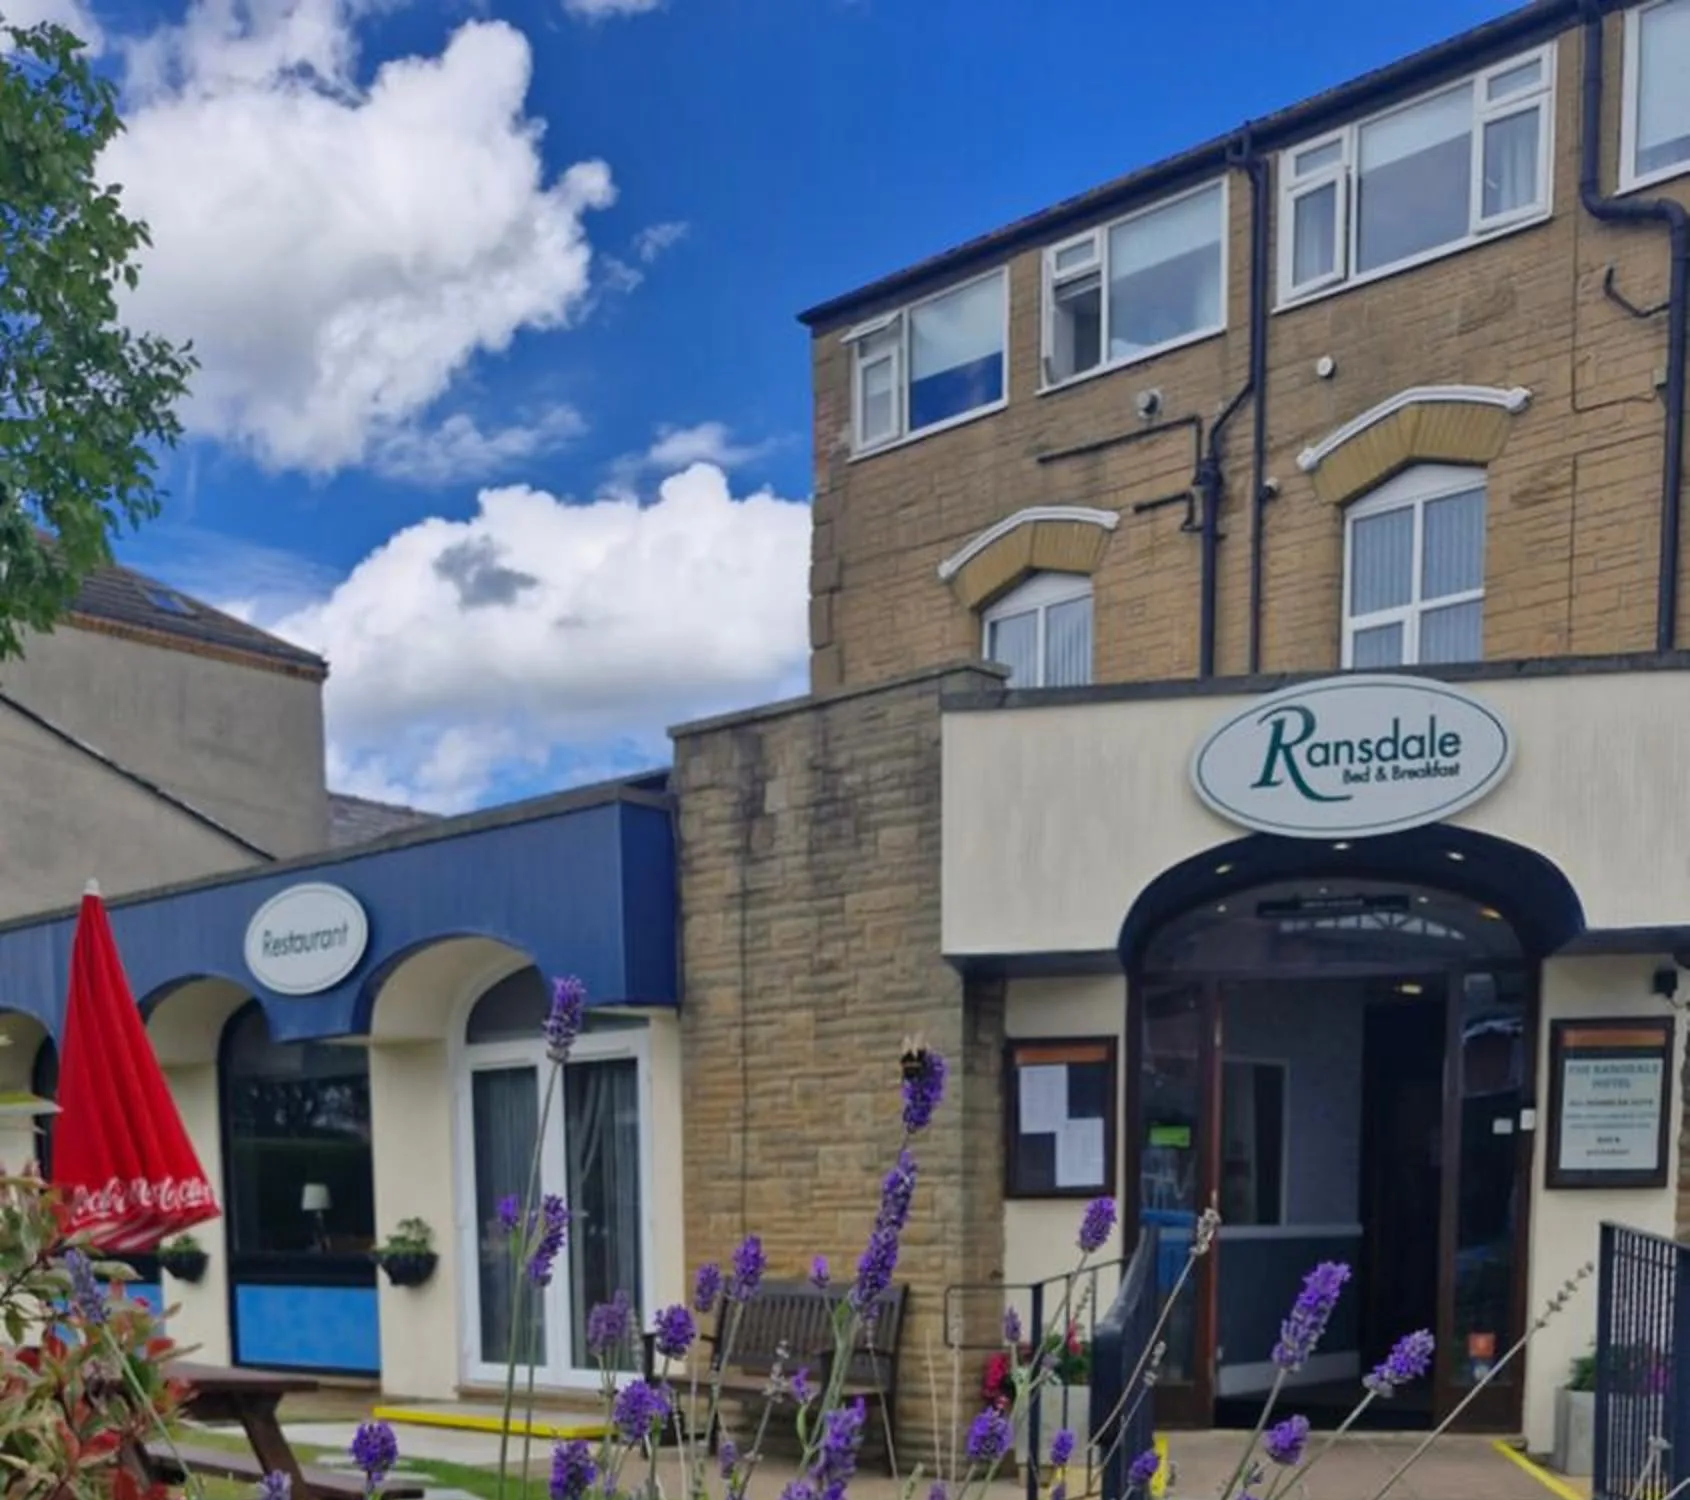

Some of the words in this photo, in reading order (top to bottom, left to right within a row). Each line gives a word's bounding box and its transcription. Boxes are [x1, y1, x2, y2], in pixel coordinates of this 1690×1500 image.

[1250, 705, 1462, 802] Ransdale
[1343, 769, 1370, 785] Bed
[1374, 767, 1387, 783] &
[1391, 763, 1461, 782] Breakfast
[262, 920, 348, 958] Restaurant
